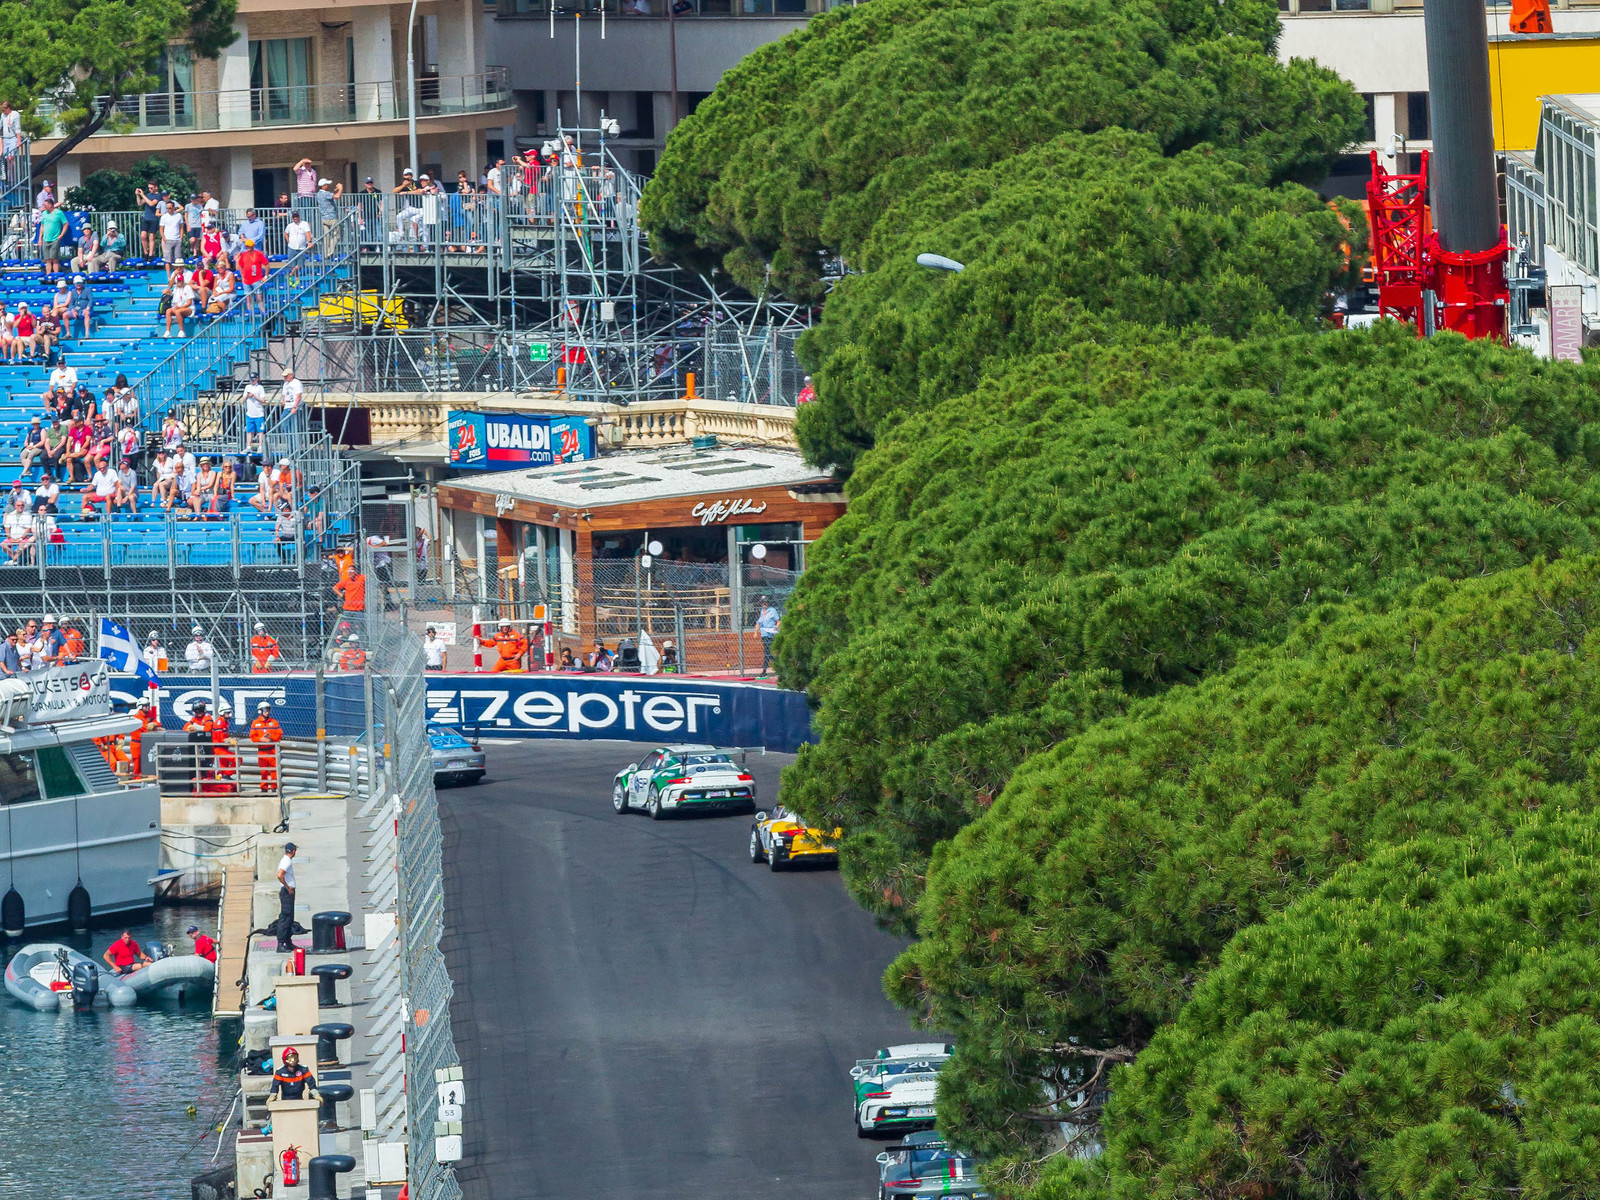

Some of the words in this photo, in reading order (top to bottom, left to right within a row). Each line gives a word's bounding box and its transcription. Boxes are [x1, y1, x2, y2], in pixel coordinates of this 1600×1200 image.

[1553, 288, 1580, 297] HOTEL
[1556, 307, 1578, 360] RAMAR
[458, 424, 476, 451] 24
[486, 423, 550, 449] UBALDI
[561, 429, 579, 456] 24
[530, 451, 551, 461] .com
[717, 498, 767, 522] Milano
[461, 690, 720, 733] zepter
